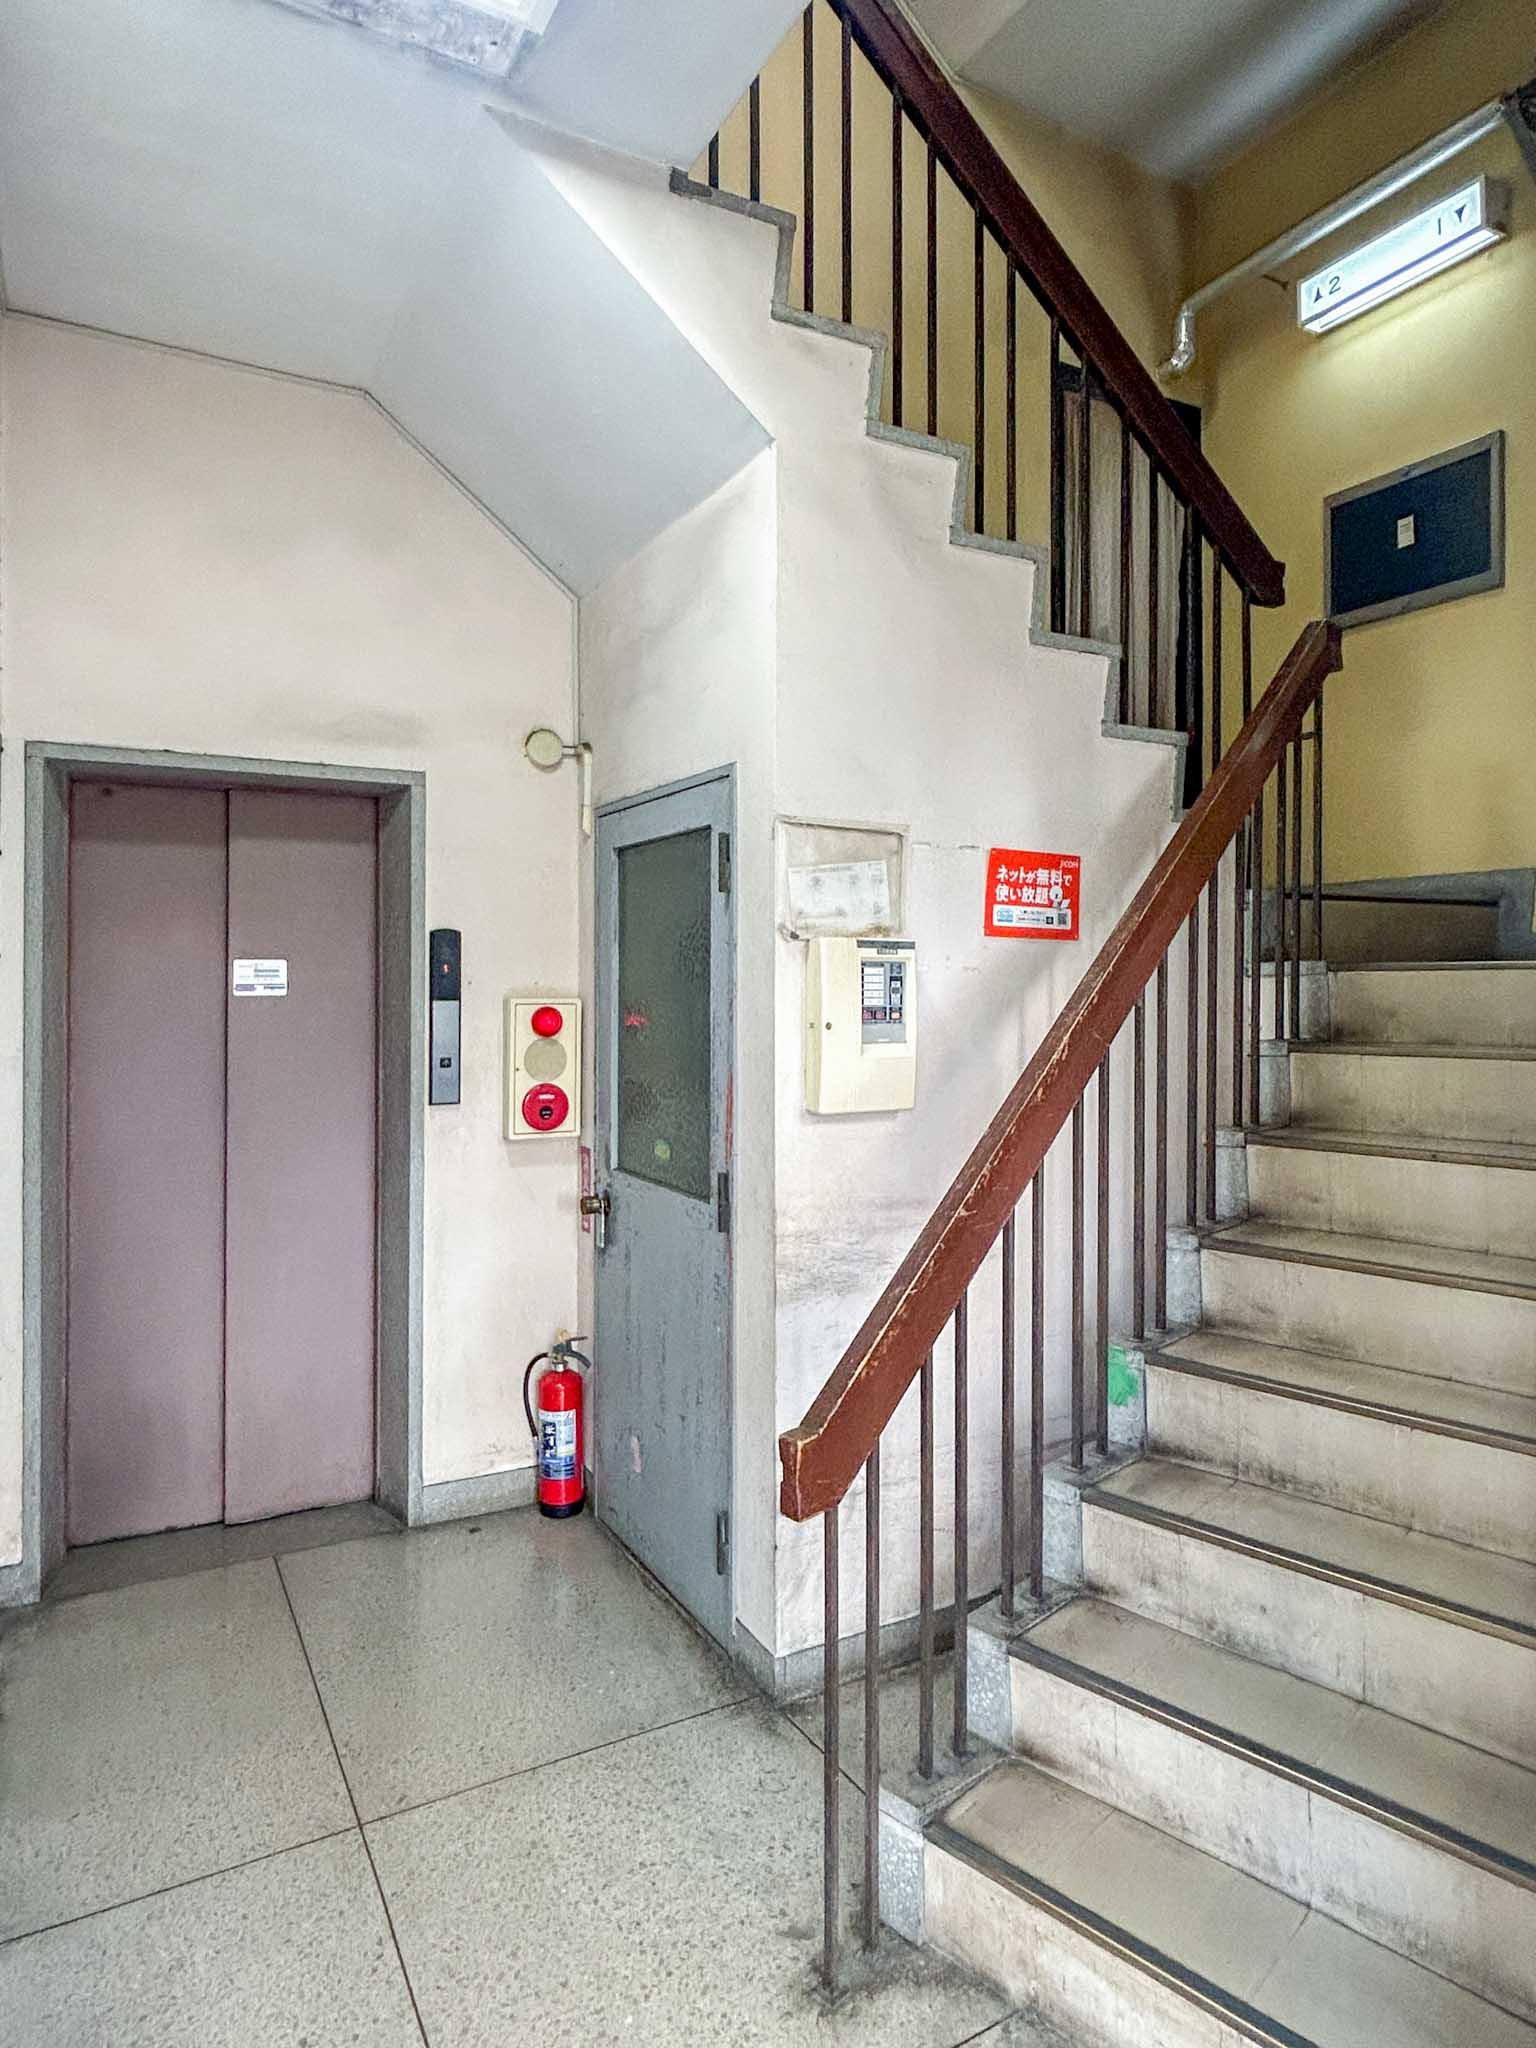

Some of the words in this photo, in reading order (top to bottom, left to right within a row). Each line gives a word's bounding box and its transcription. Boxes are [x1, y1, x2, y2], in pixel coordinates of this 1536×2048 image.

[1328, 275, 1341, 296] 2
[996, 864, 1072, 887] ネットが無料で
[995, 883, 1049, 904] 使い放題
